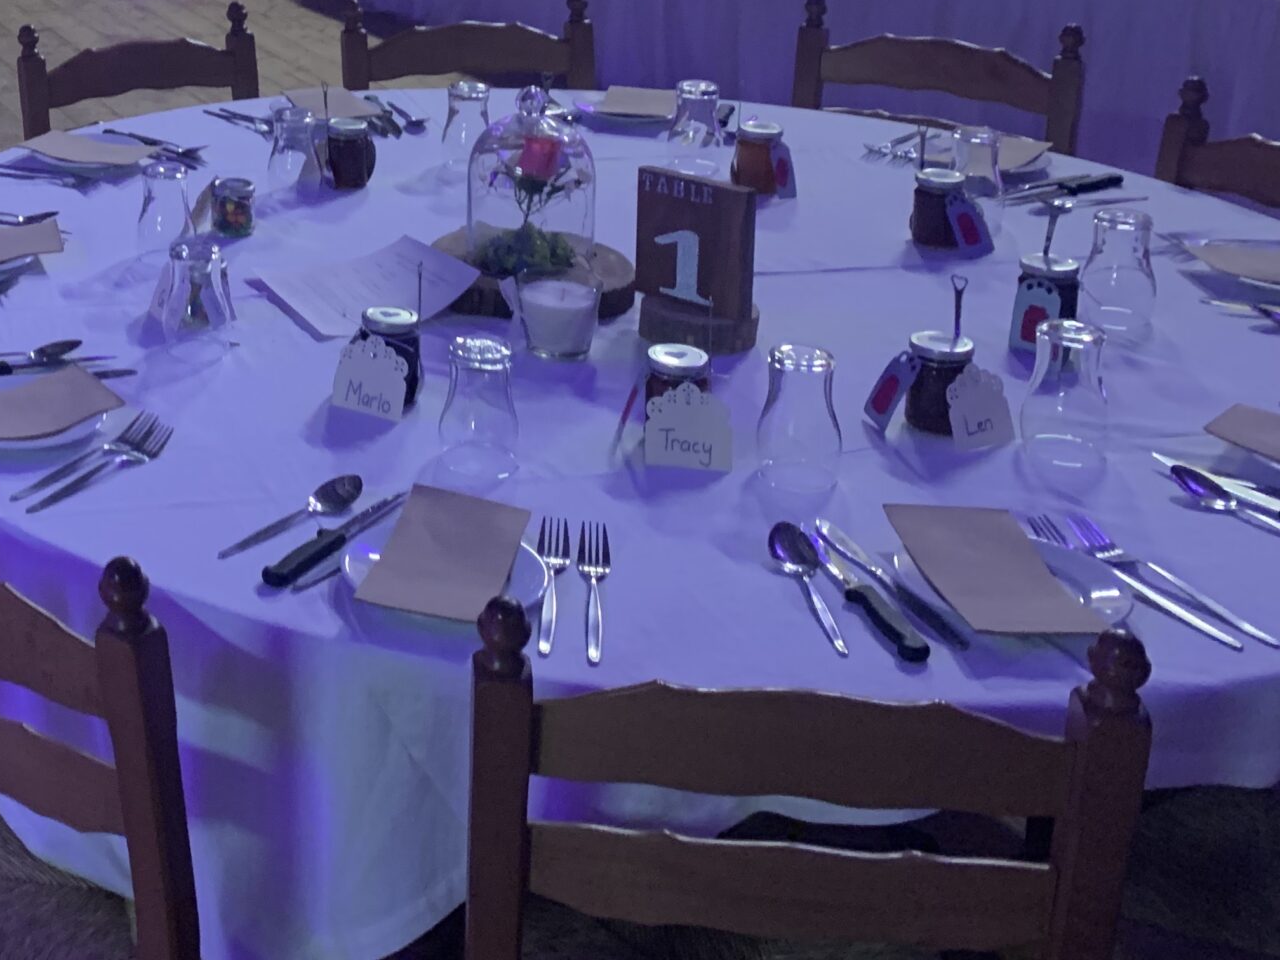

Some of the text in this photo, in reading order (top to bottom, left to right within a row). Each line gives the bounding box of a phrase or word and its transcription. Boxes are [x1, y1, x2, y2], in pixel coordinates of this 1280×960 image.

[642, 172, 713, 204] TABLE
[654, 230, 713, 306] 1
[345, 379, 391, 414] Marlo
[962, 414, 994, 436] Len
[658, 427, 712, 468] Tracy
